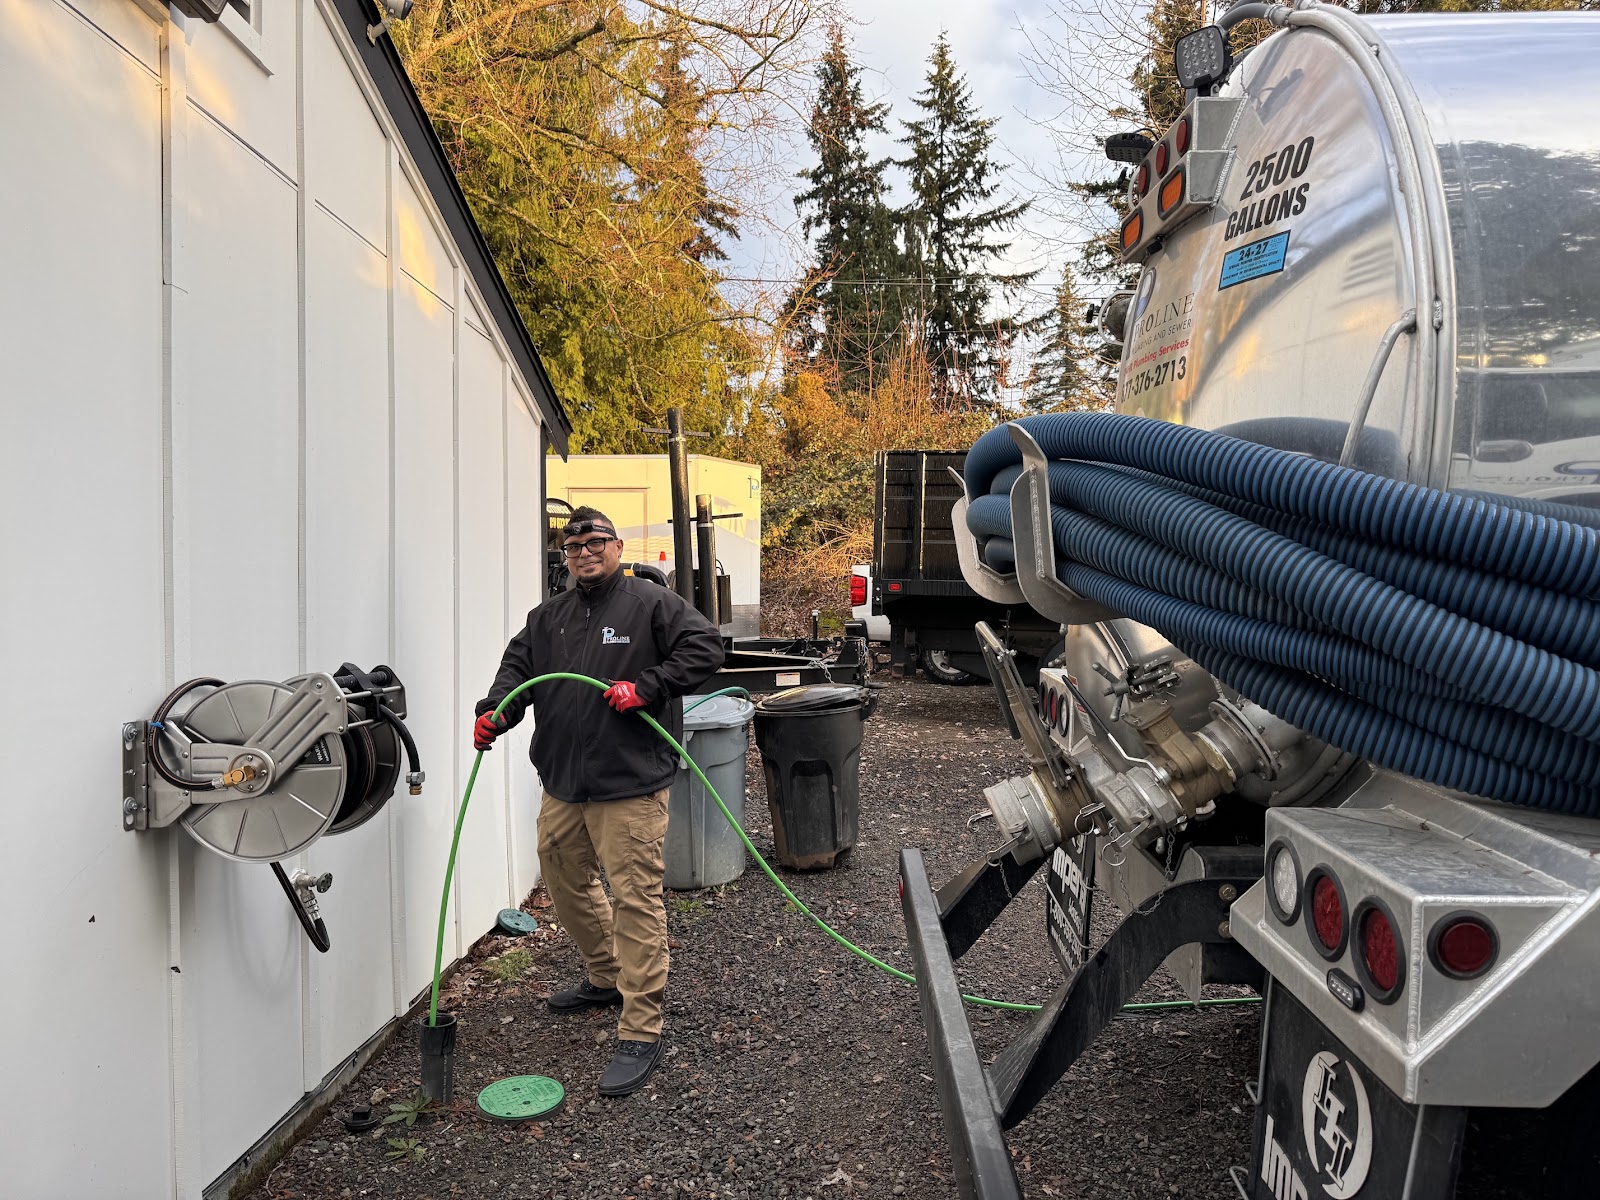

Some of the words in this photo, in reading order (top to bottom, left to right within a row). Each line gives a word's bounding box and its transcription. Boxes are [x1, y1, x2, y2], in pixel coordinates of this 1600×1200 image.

[1240, 136, 1314, 201] 2500
[1224, 183, 1310, 241] GALLONS
[1133, 293, 1194, 341] PROLINE
[1168, 319, 1192, 335] SEWER
[1159, 339, 1190, 356] Services
